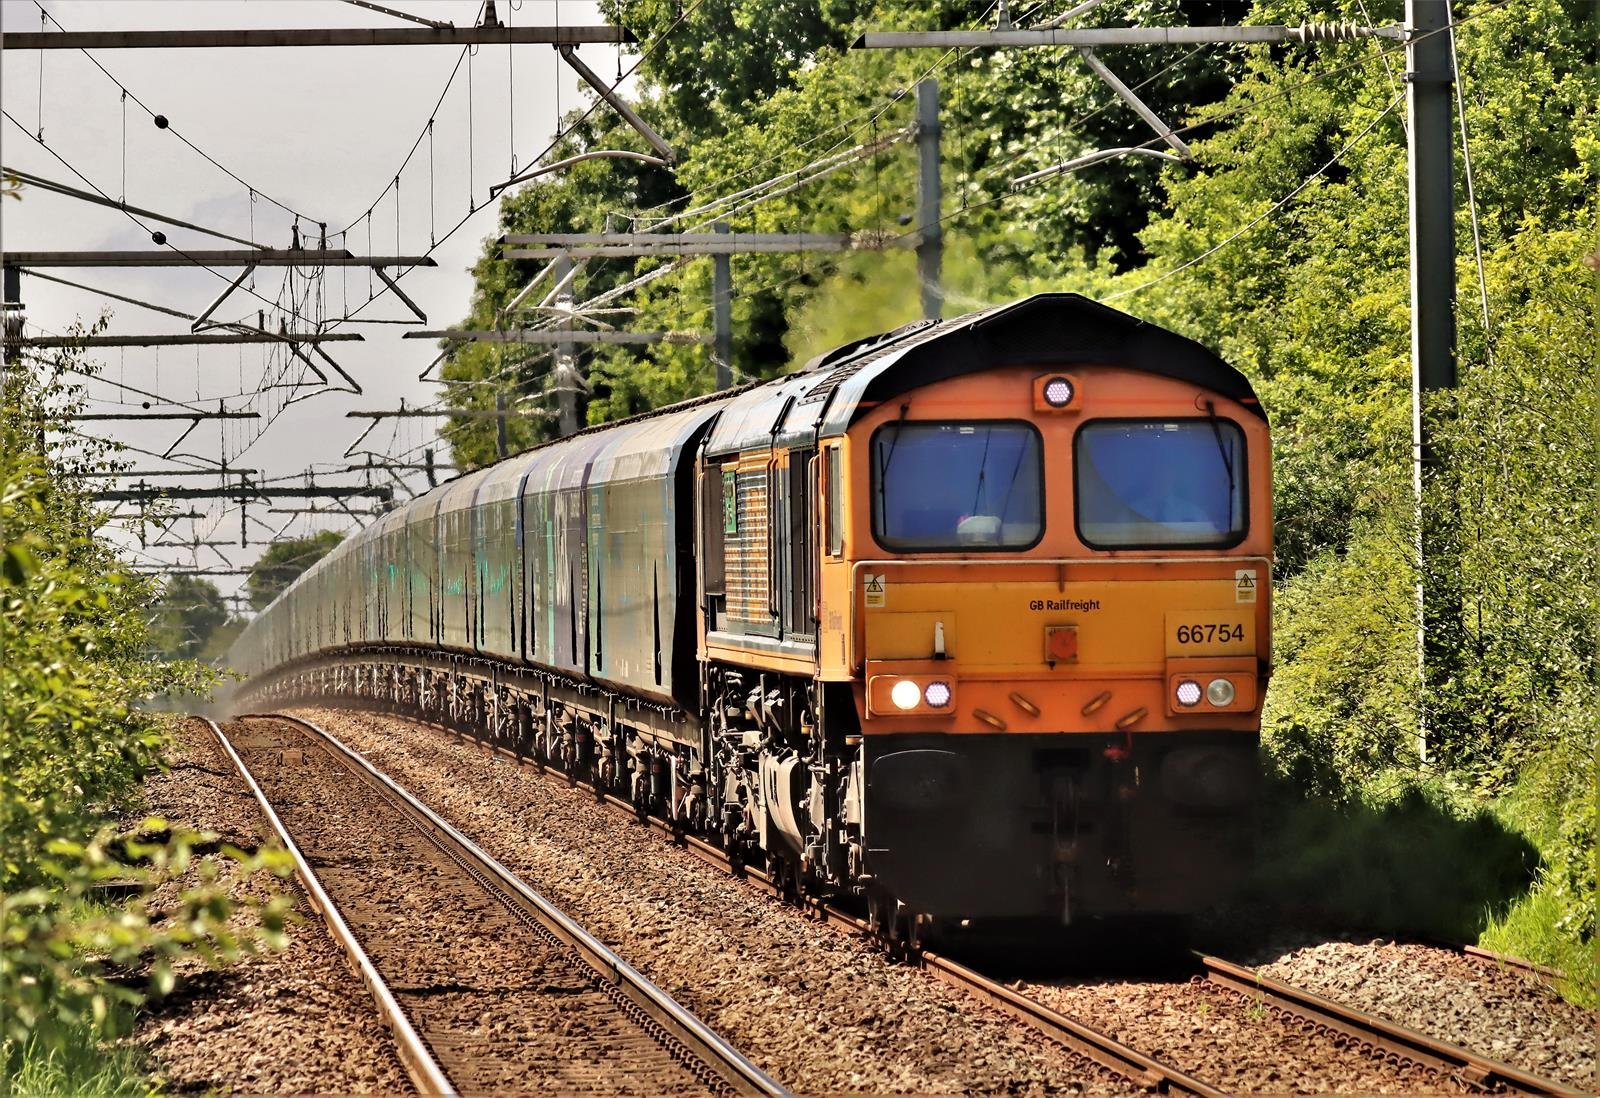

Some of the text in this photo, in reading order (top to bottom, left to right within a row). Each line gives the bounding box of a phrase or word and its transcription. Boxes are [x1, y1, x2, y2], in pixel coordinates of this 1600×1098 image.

[1030, 599, 1100, 612] GB Railfreight
[1177, 624, 1244, 644] 66754
